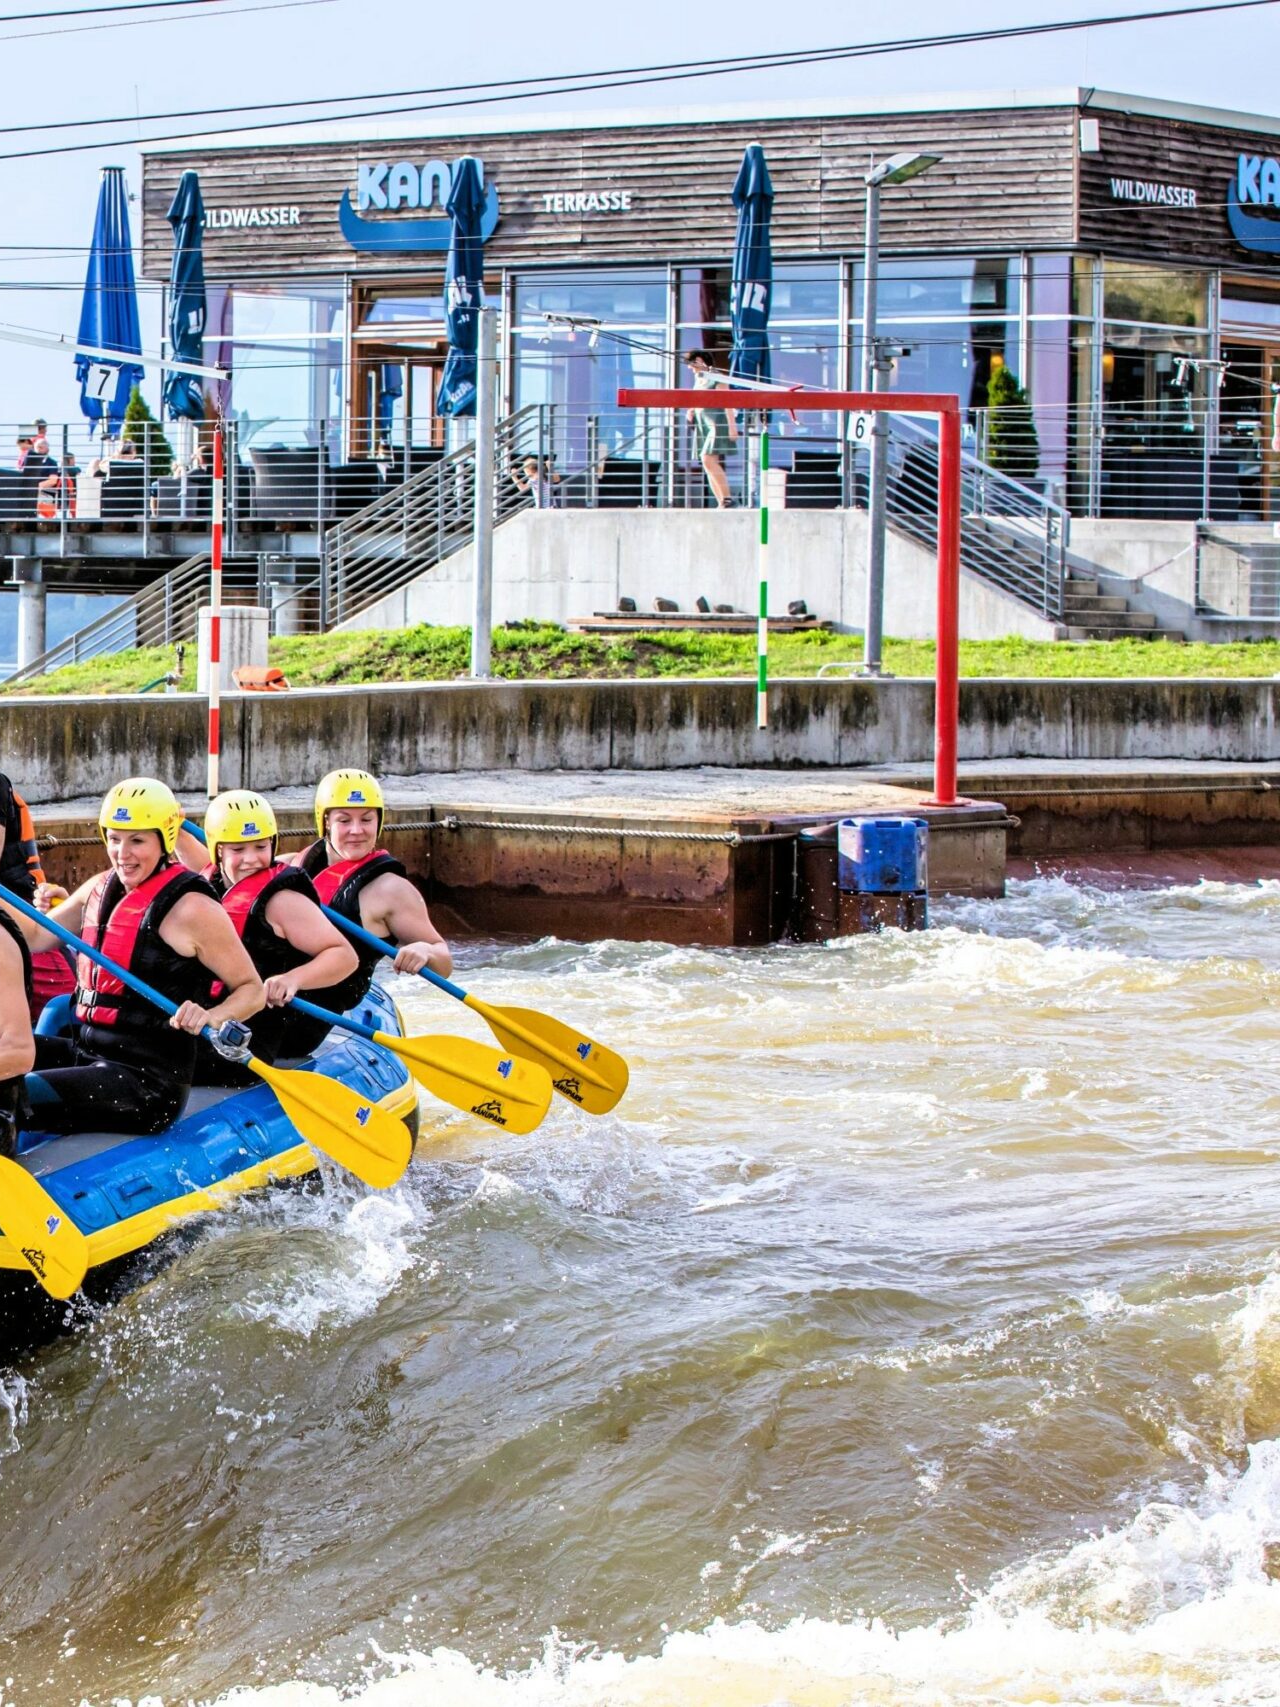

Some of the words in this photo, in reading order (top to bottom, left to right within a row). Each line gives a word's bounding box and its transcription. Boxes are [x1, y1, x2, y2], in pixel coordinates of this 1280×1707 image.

[543, 191, 632, 213] TERRASSE
[1110, 178, 1197, 208] WILDWASSER
[201, 206, 300, 228] ILDWASSER
[97, 368, 111, 396] 7
[855, 416, 865, 439] 6
[470, 1105, 508, 1126] KANUPARK
